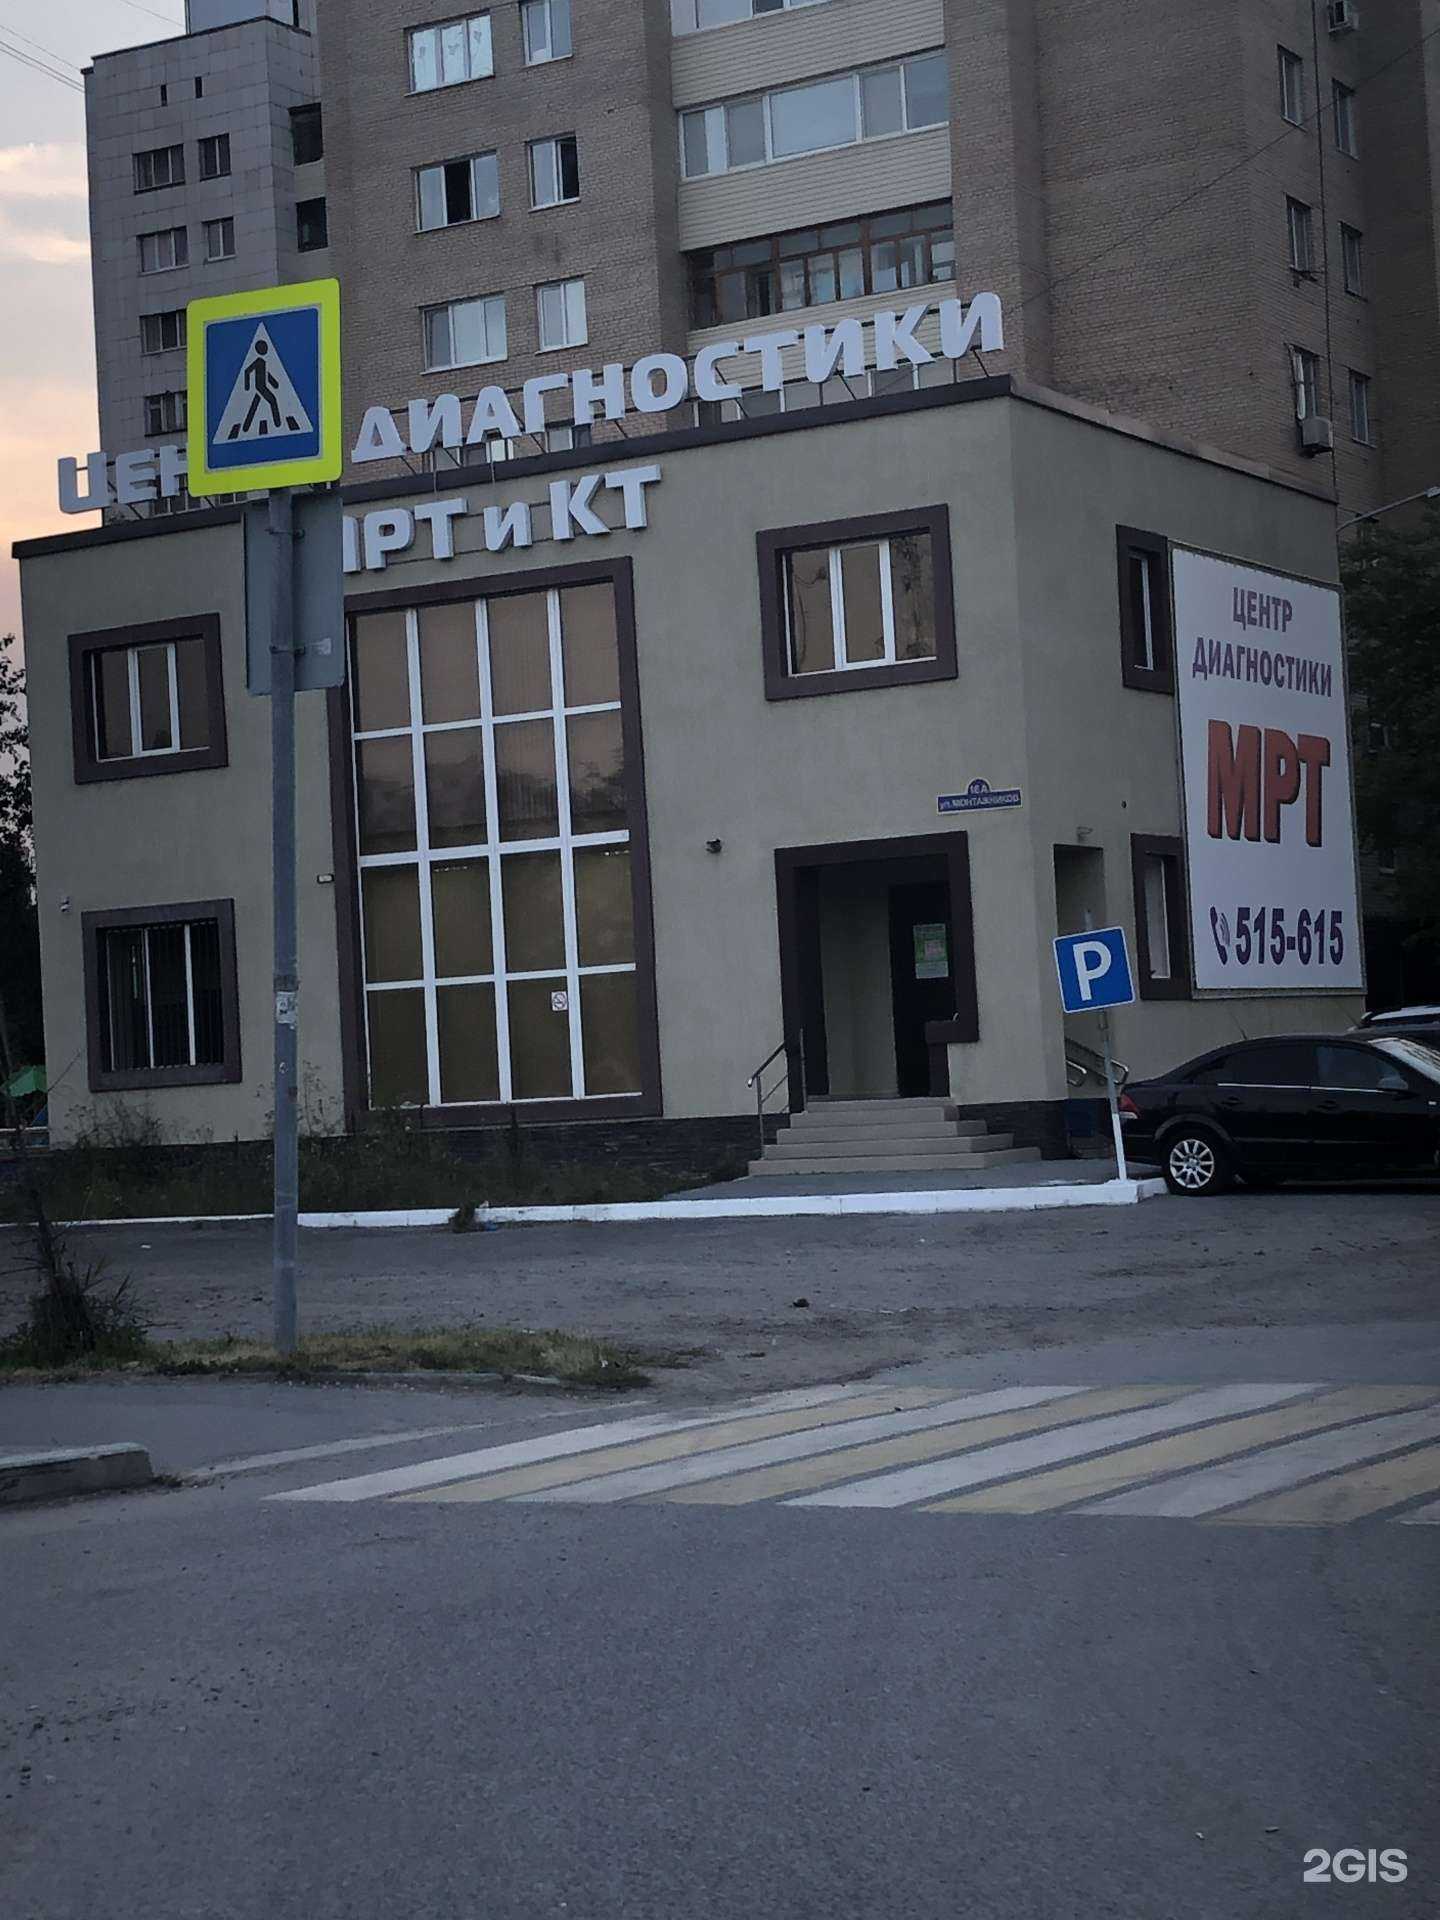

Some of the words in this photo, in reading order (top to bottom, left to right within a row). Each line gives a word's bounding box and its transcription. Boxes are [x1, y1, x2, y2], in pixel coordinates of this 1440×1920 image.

[57, 444, 188, 515] ЦЕН
[351, 291, 1004, 462] ДИАГНОСТИКИ
[549, 464, 661, 540] КТ
[1232, 586, 1293, 632] ЦЕНТР
[1192, 637, 1333, 698] ДИАГНОСТИКИ
[1207, 719, 1331, 848] МРТ
[1235, 906, 1344, 966] 515-615
[1072, 940, 1112, 1001] P
